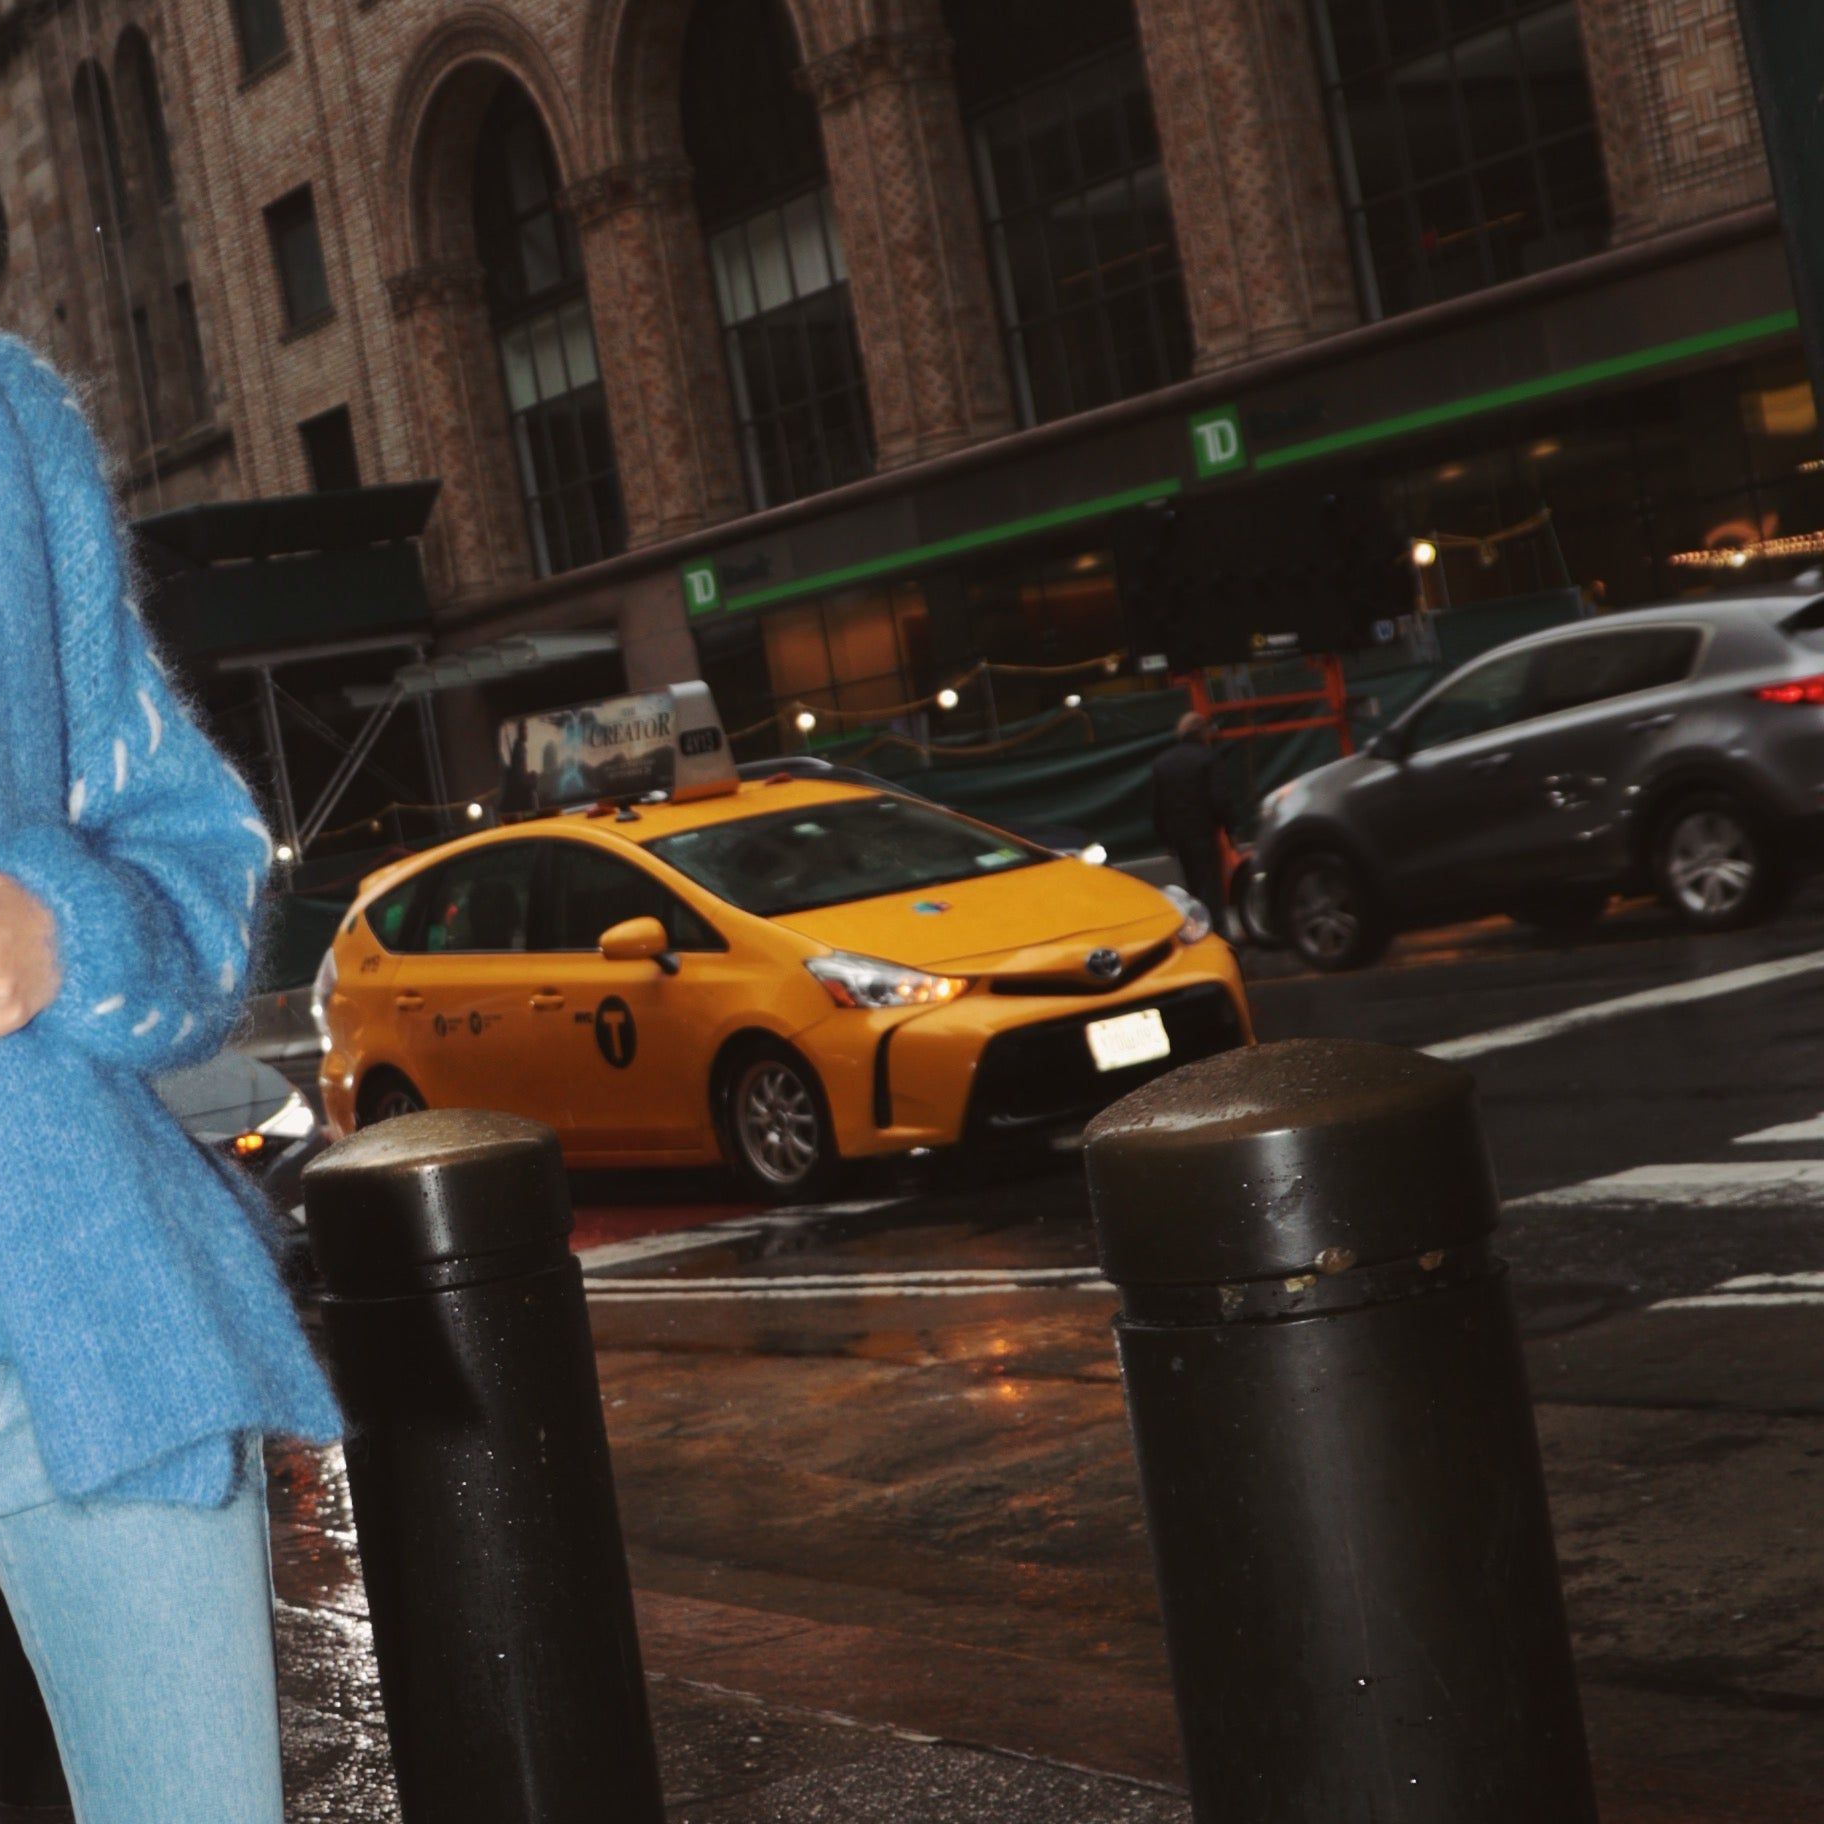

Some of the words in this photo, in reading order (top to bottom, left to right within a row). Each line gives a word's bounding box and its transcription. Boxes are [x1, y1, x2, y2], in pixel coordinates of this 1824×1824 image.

[1195, 418, 1239, 464] TD
[687, 569, 716, 605] TD
[590, 712, 670, 748] CREATOR
